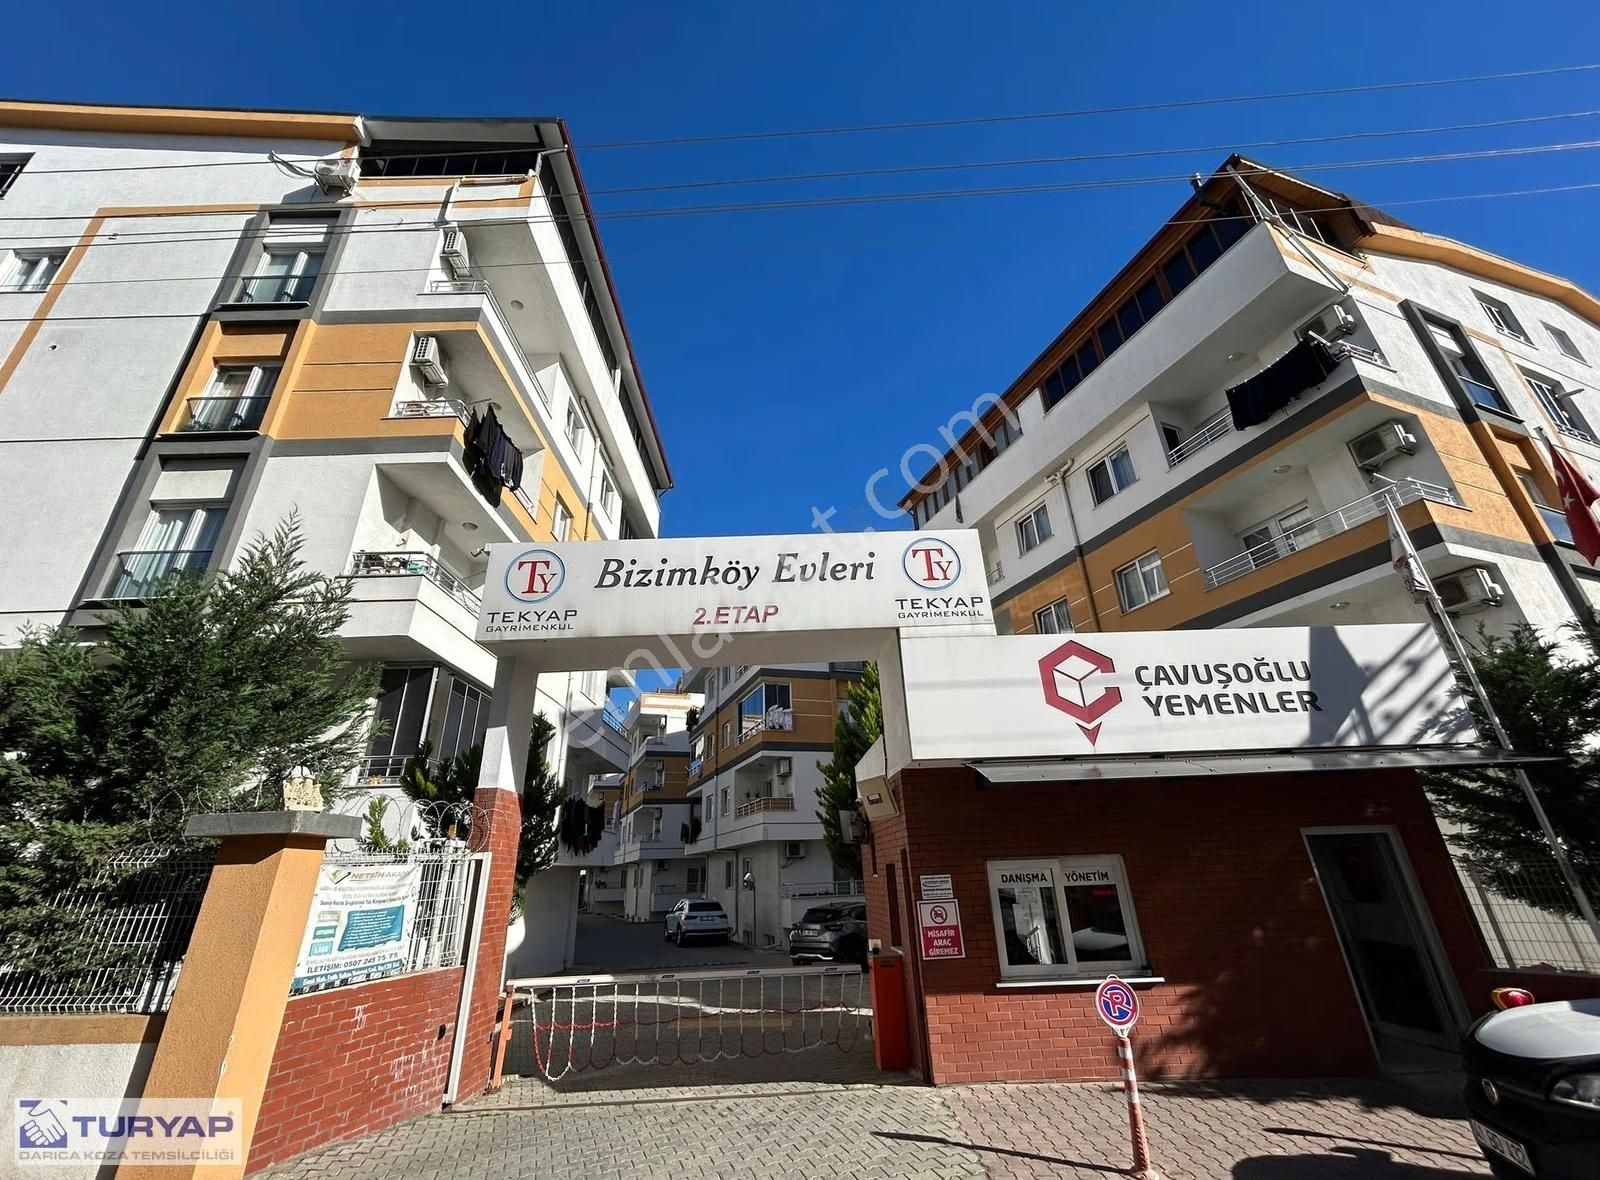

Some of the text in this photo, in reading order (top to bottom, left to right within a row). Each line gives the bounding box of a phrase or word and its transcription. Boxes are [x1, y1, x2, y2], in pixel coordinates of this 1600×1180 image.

[594, 551, 876, 592] Bizimköy Evleri
[894, 596, 984, 610] TEKYAP
[487, 609, 578, 623] TEKYAP
[692, 603, 780, 626] 2.ETAP
[898, 609, 984, 619] GAYRİMENKUL
[485, 623, 575, 633] GAYRİMENKUL
[1134, 656, 1312, 692] ÇAVUŞOĞLU
[1142, 690, 1323, 717] YEMENLER
[351, 871, 384, 879] NETSİN
[1000, 871, 1048, 884] DANIŞMA
[1064, 869, 1109, 882] YÖNETİM
[927, 929, 956, 938] MİSAFİR
[933, 938, 952, 948] ARAÇ
[928, 947, 959, 956] GİREMEZ
[307, 962, 342, 974] İLETİŞİM:
[344, 959, 362, 968] 0507
[377, 954, 386, 962] 75
[389, 952, 398, 960] 75
